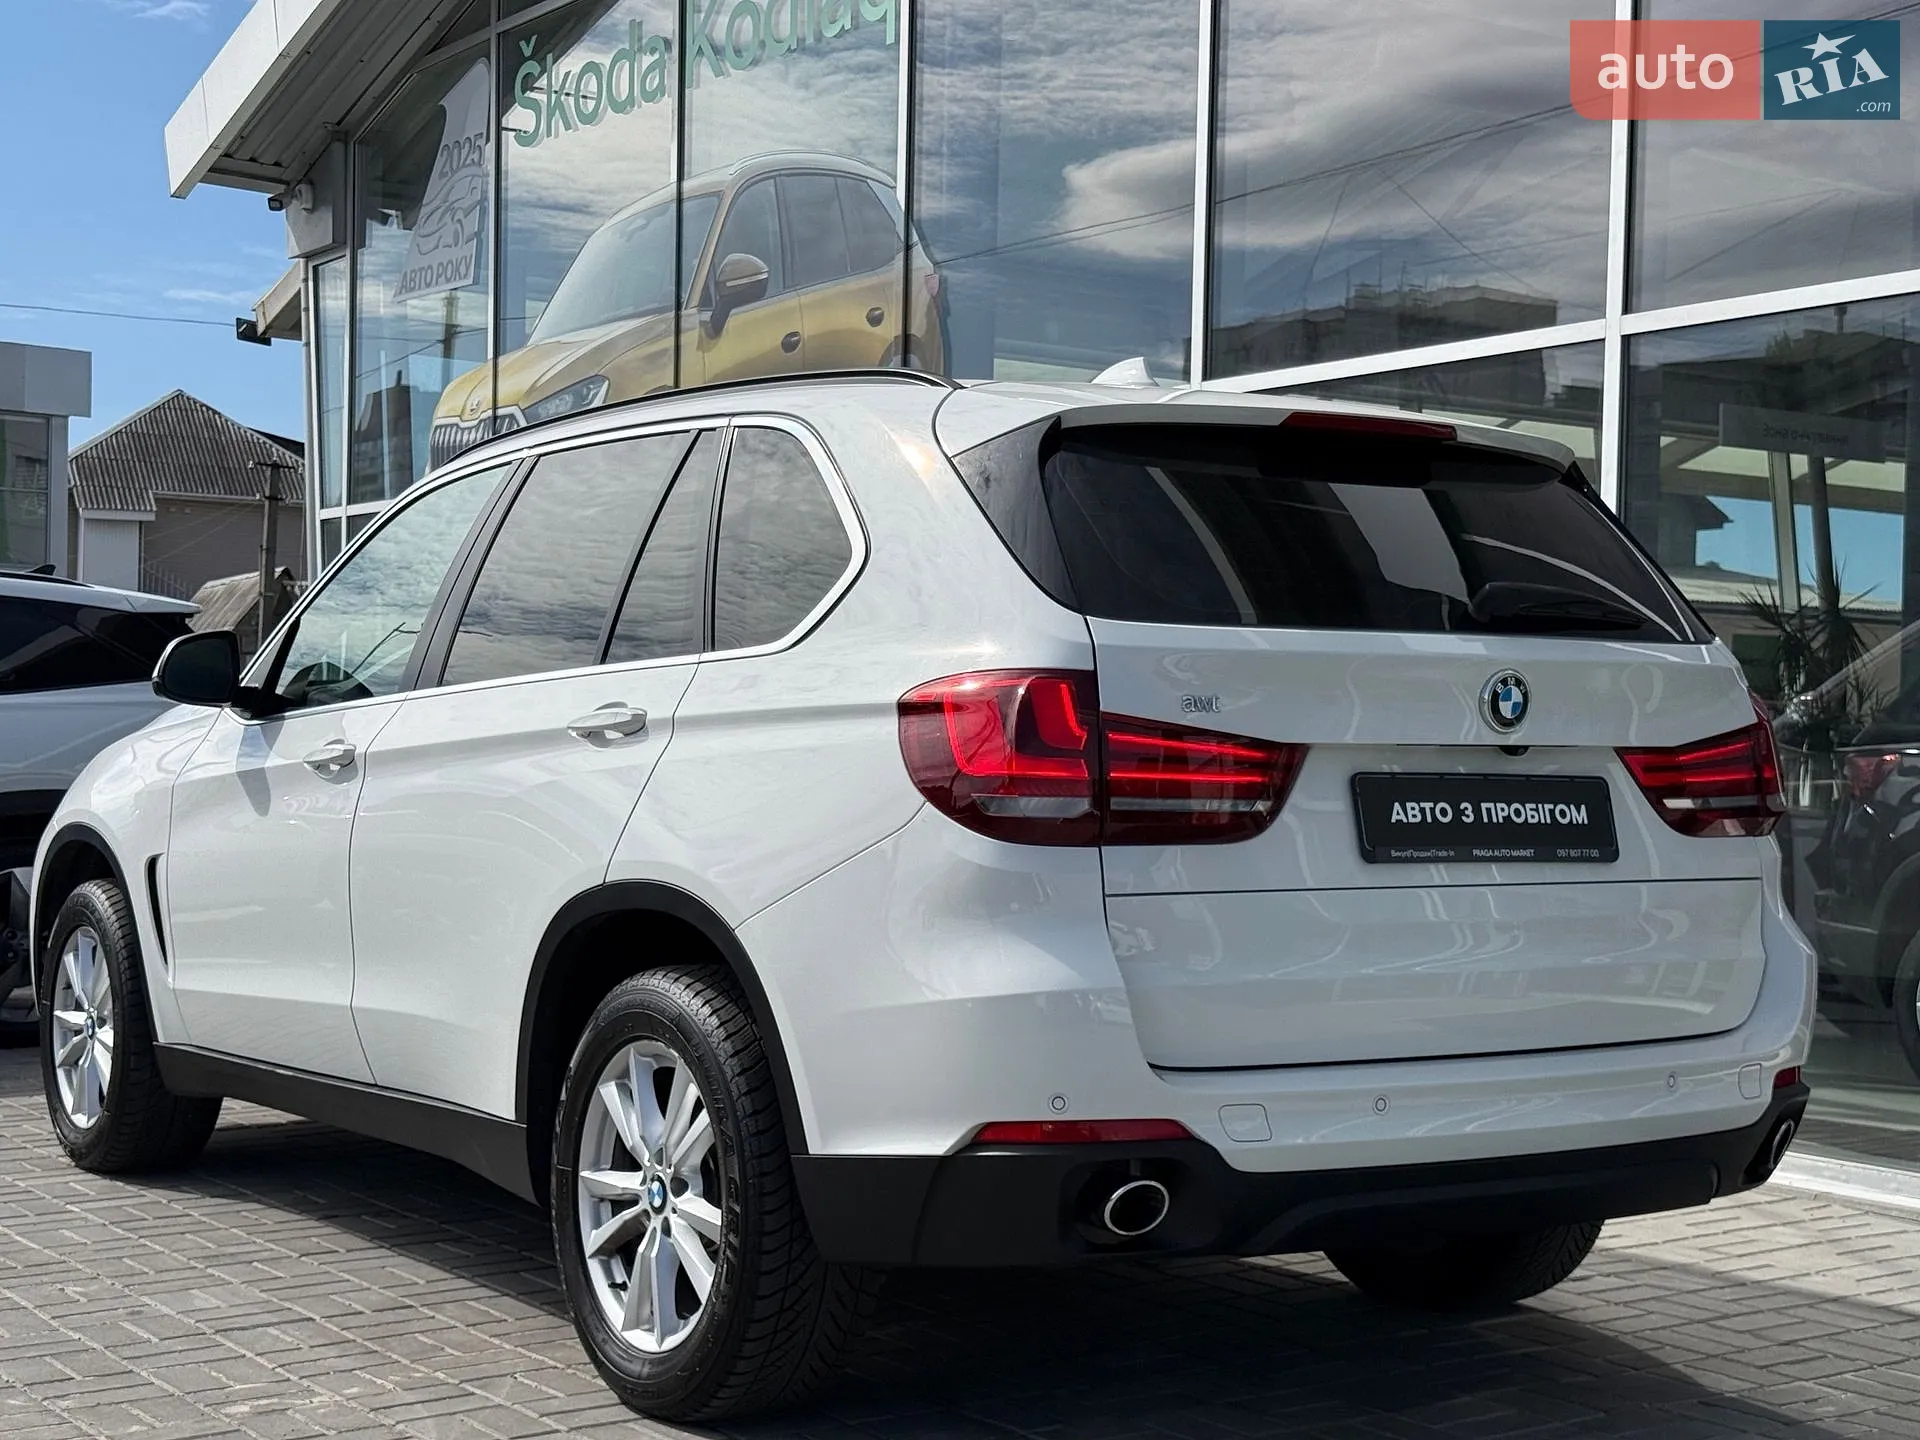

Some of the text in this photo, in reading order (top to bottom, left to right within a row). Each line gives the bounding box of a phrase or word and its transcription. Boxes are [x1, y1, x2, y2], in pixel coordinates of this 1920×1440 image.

[514, 18, 670, 148] Škoda
[438, 132, 484, 180] 2025
[399, 254, 473, 295] АВТО РОКУ
[1390, 802, 1453, 823] АВТО
[1480, 802, 1588, 825] ПРОБІГОМ
